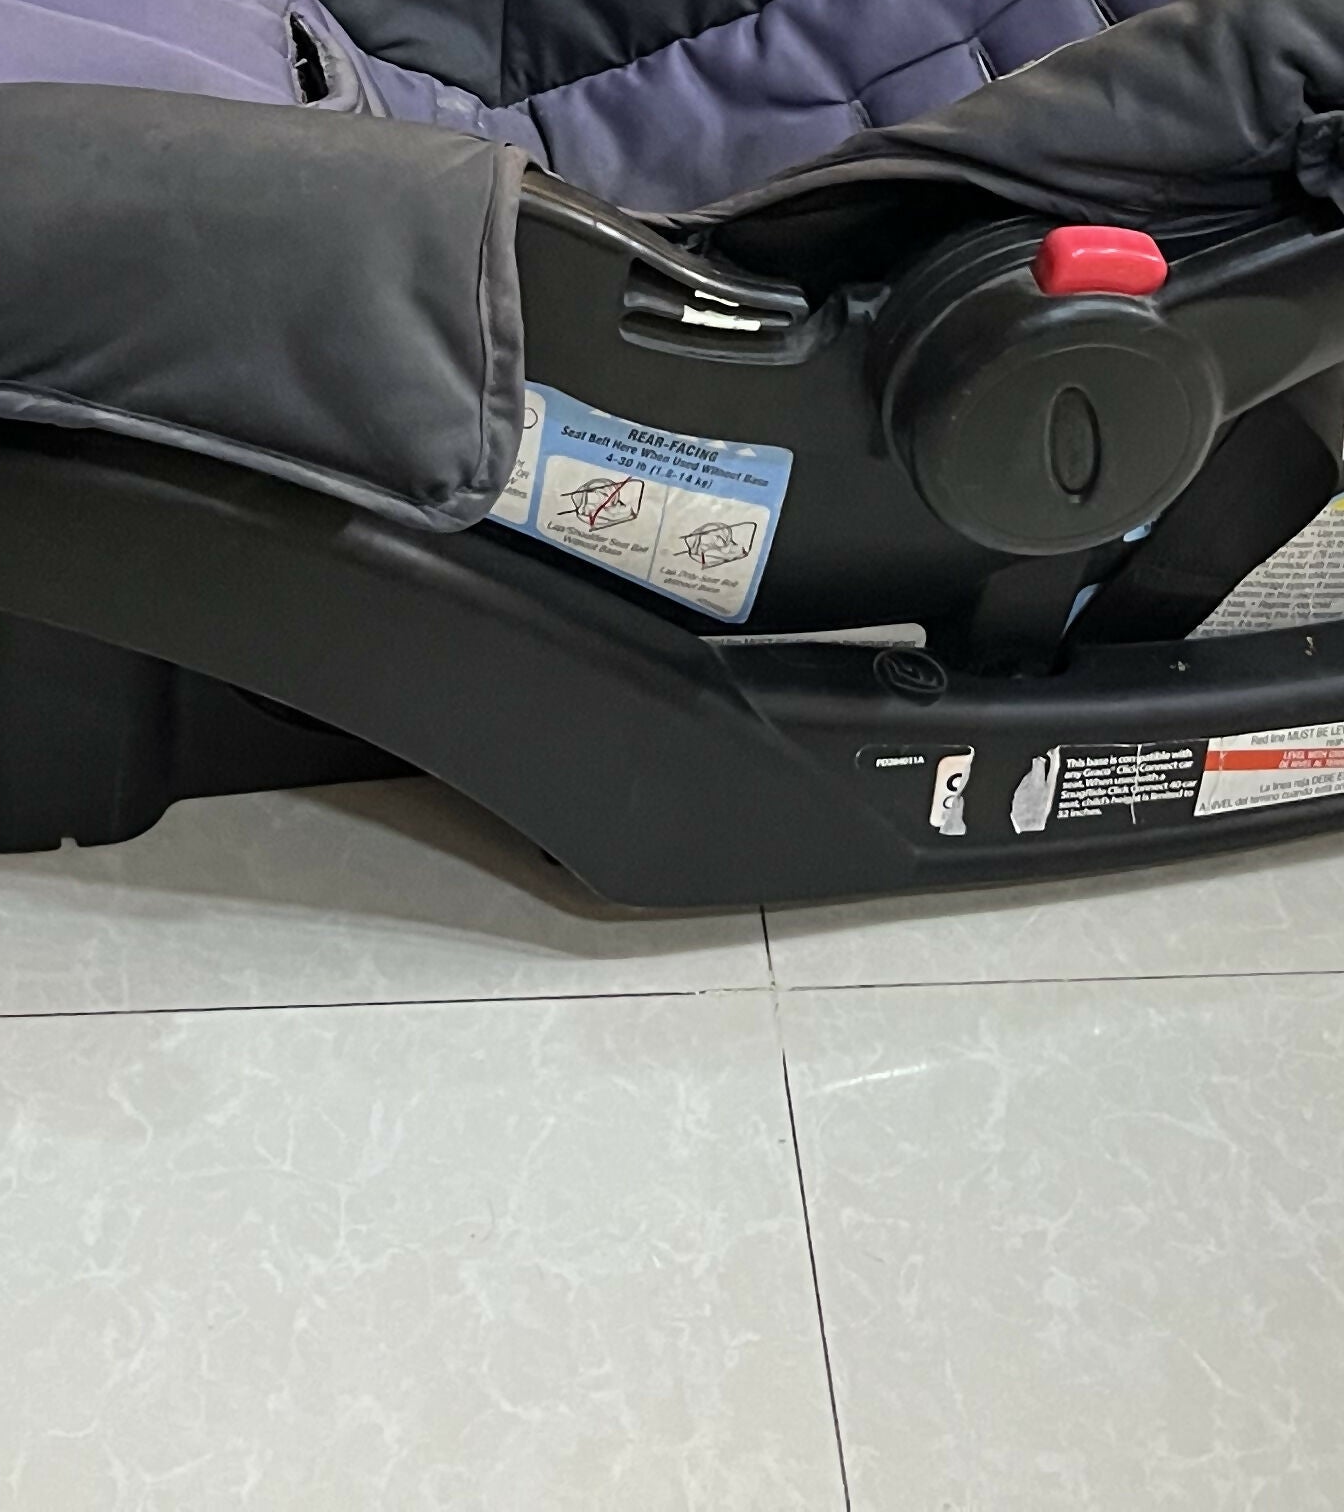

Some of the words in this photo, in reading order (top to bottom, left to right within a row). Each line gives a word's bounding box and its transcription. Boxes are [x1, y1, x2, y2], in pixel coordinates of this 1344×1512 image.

[560, 424, 587, 443] Seat
[588, 430, 611, 447] Belt
[612, 437, 638, 456] Here
[640, 447, 670, 464] When
[672, 454, 700, 473] Used
[700, 462, 742, 482] Without
[627, 428, 719, 463] REAR-FACING
[605, 452, 634, 468] 4-30
[1287, 729, 1315, 742] MUST
[1316, 727, 1329, 738] BE
[1066, 757, 1085, 769] This
[1086, 756, 1109, 767] base
[1109, 754, 1118, 765] is
[1118, 750, 1171, 765] compatible
[1171, 748, 1193, 759] with
[1064, 771, 1082, 780] any
[1083, 767, 1112, 778] Graco
[1139, 761, 1178, 773] Connect
[1178, 760, 1195, 769] car
[1085, 778, 1114, 788] When
[1130, 782, 1169, 793] Connect
[1169, 780, 1183, 789] 40
[1182, 779, 1199, 788] car
[1311, 773, 1336, 785] DEBE
[1110, 793, 1141, 806] height
[1141, 791, 1150, 802] is
[1150, 789, 1183, 800] limited
[1183, 789, 1195, 798] to
[1282, 786, 1313, 801] cuando
